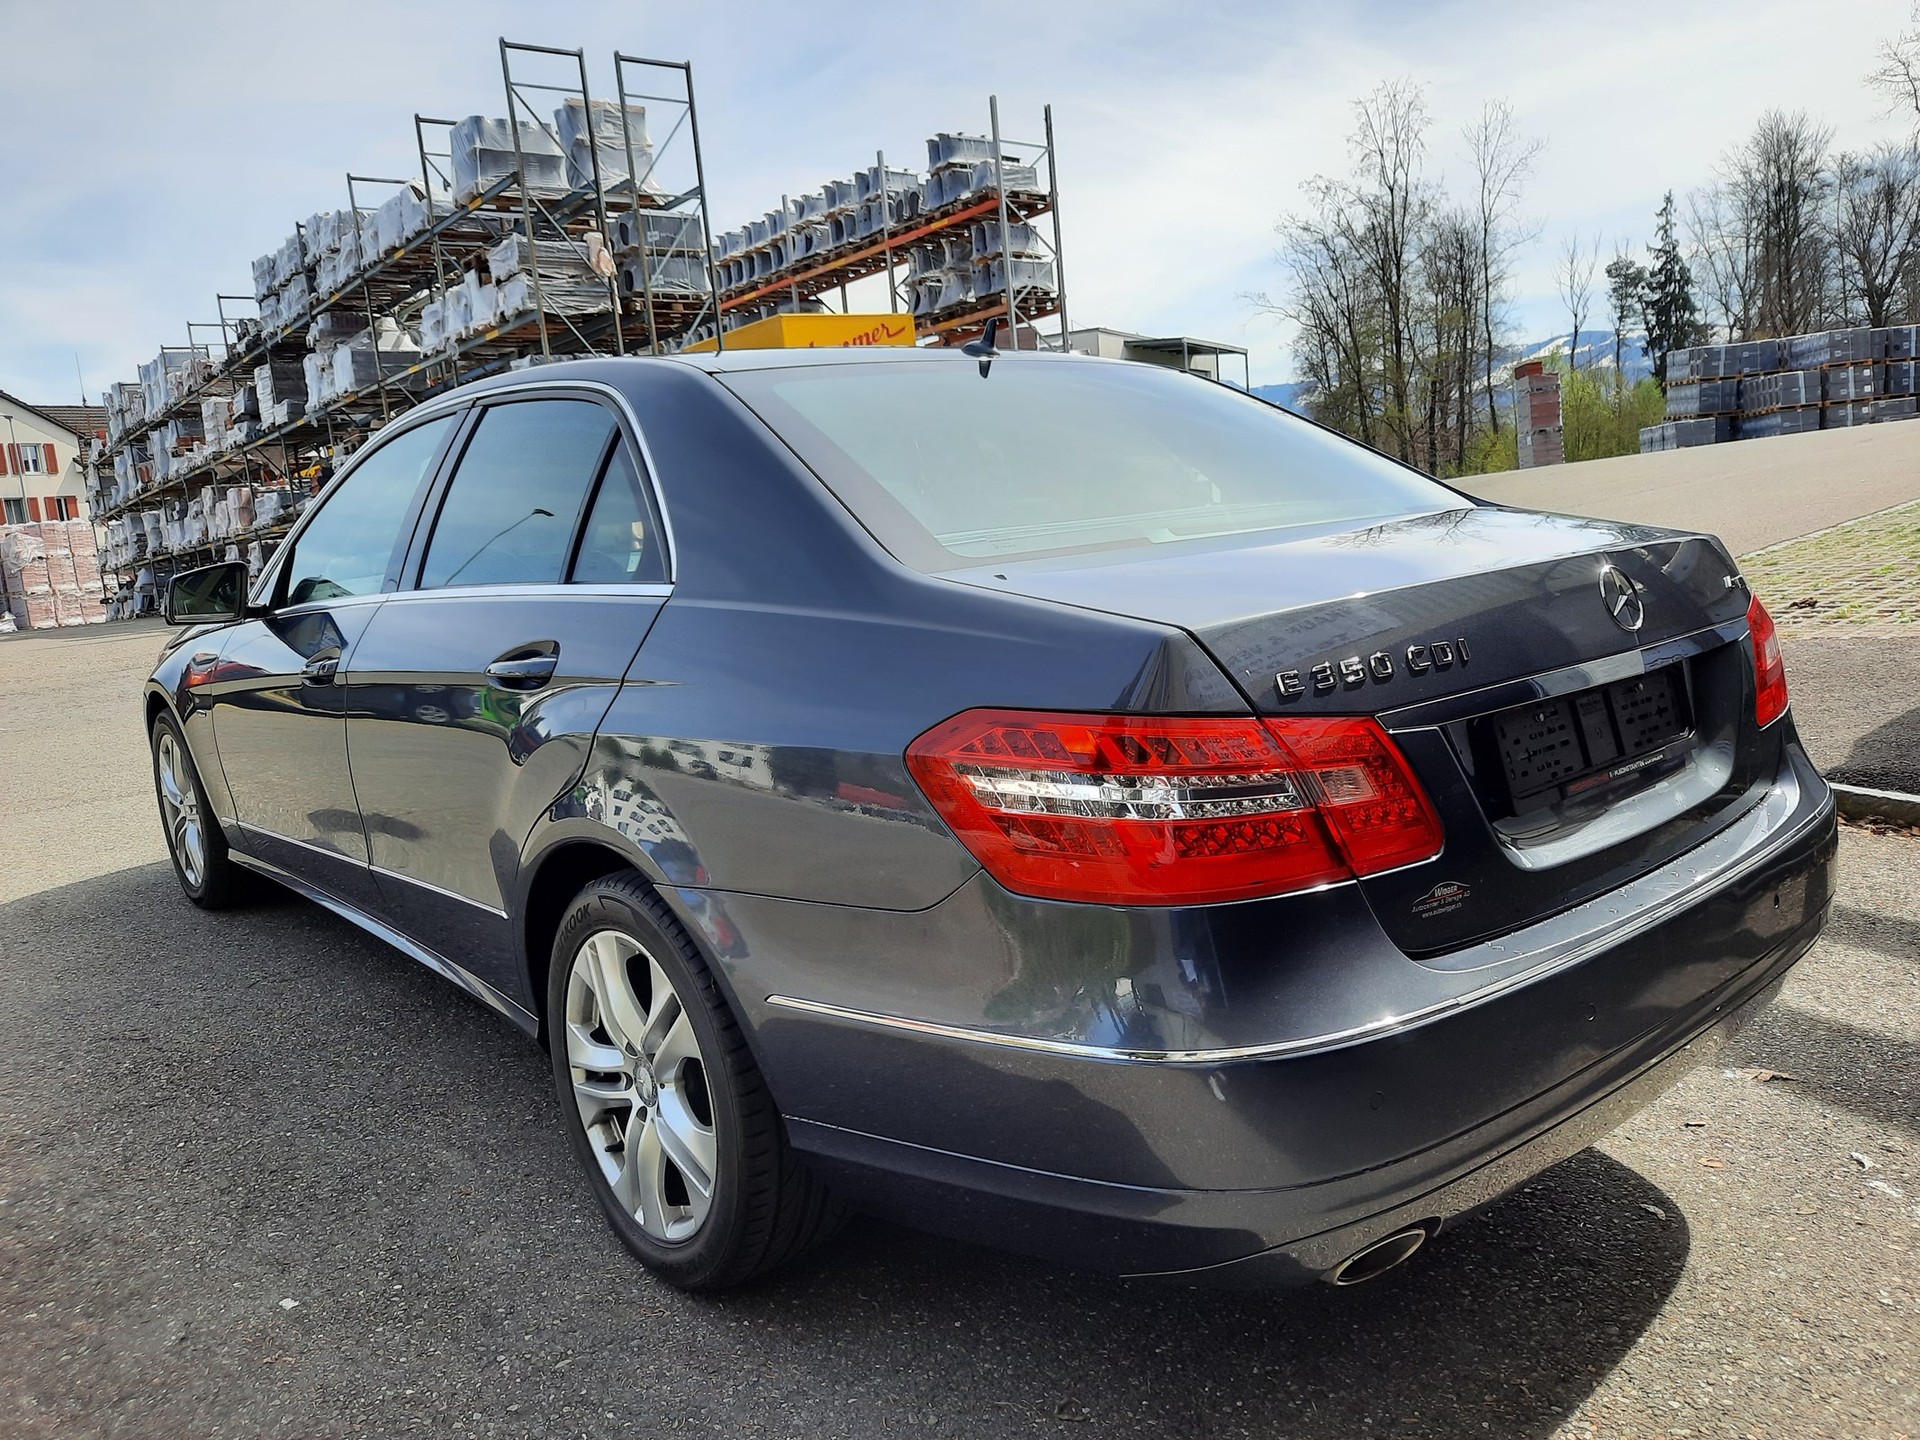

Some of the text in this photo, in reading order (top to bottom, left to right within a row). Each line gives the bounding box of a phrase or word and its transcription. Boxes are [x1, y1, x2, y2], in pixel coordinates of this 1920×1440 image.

[1275, 637, 1471, 696] E 350 CDI
